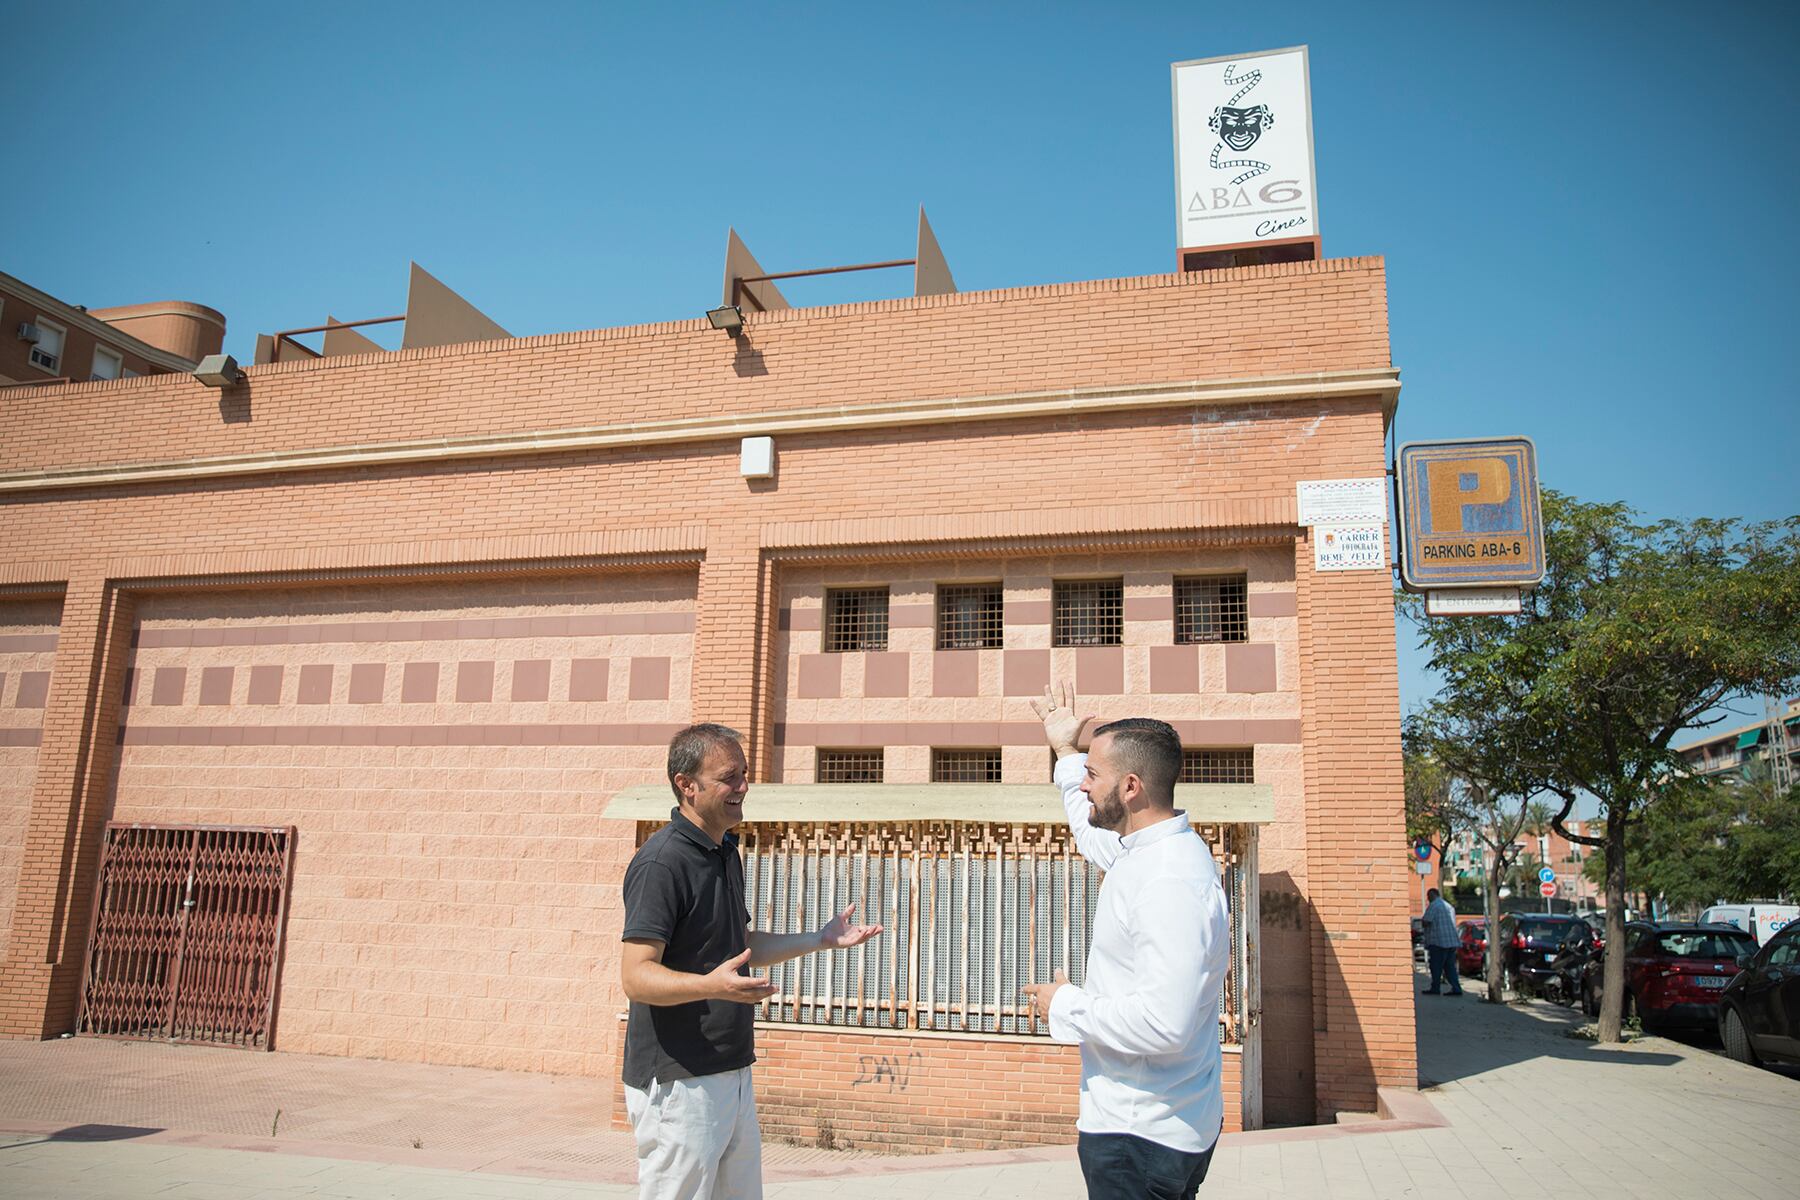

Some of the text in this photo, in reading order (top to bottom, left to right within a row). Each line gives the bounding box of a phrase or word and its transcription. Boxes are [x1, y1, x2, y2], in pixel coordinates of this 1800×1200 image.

[1258, 180, 1303, 204] 6
[1256, 216, 1307, 237] Cines
[1426, 457, 1511, 533] P
[1340, 533, 1379, 542] CARRER
[1320, 553, 1344, 562] REME
[1423, 541, 1521, 559] PARKING ABA-6
[1446, 594, 1496, 607] ENTRADA
